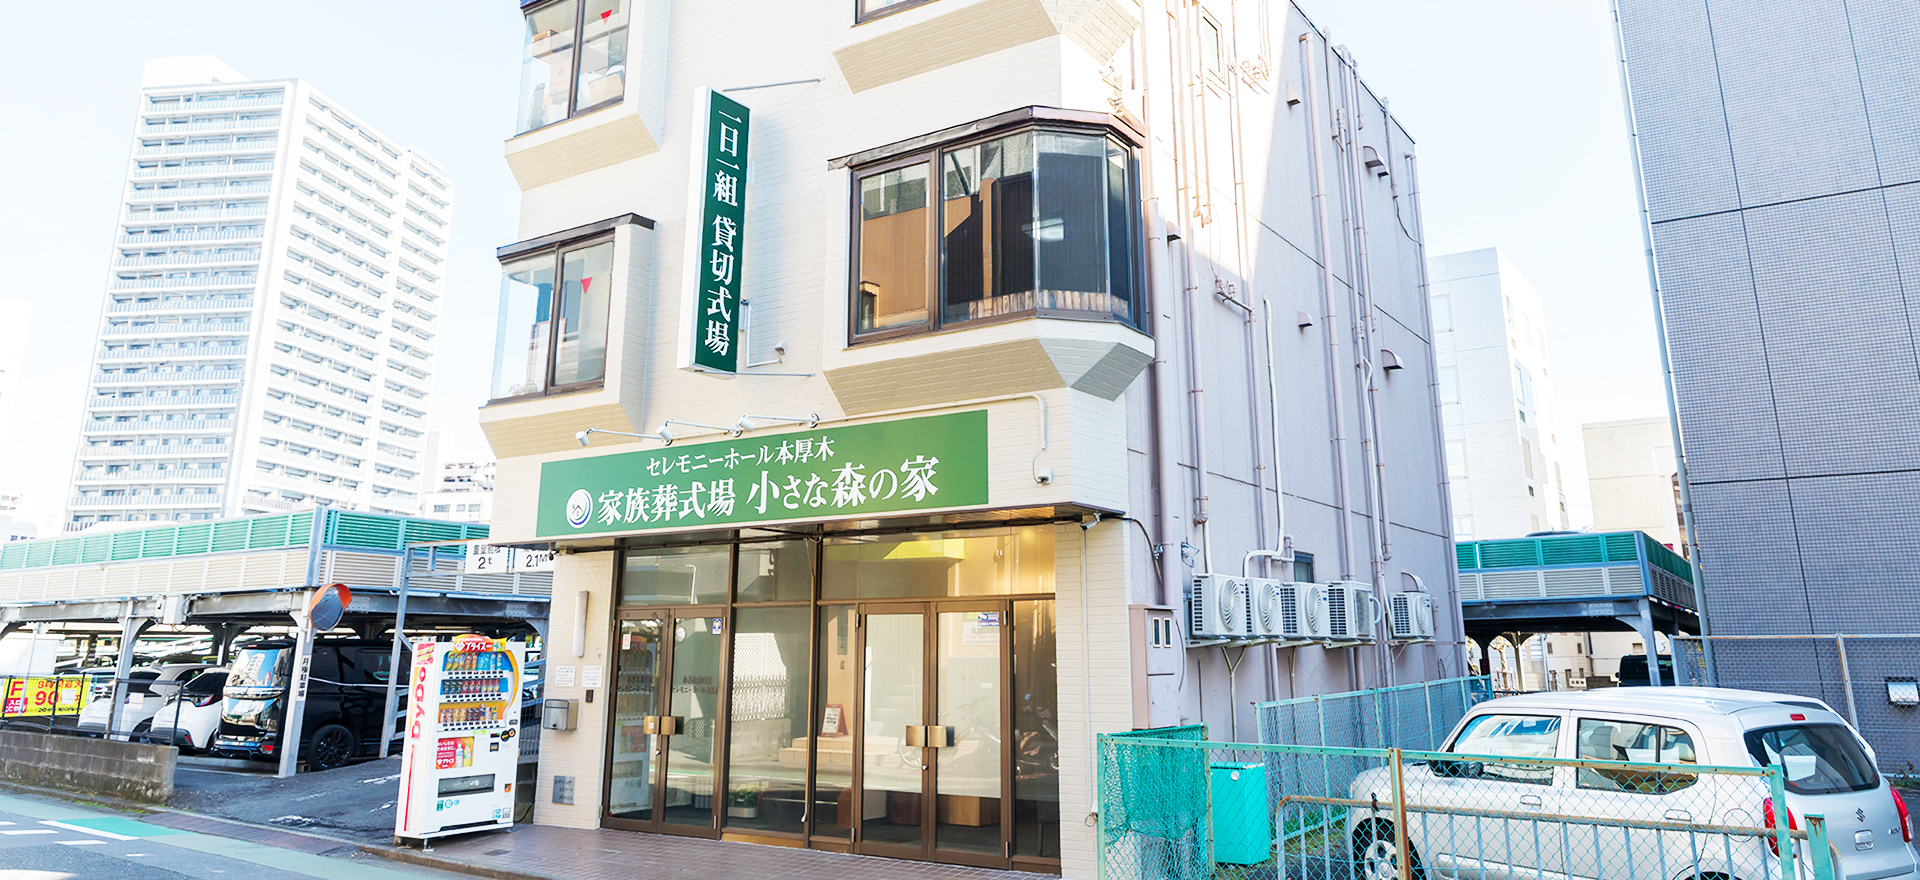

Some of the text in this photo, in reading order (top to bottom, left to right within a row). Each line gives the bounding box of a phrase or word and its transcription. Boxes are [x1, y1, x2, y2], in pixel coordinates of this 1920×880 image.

[705, 109, 742, 357] 一日一組 貸切式場
[597, 455, 939, 525] 家族葬式場 小さな森の家
[646, 436, 835, 477] セレモニーホール本厚木
